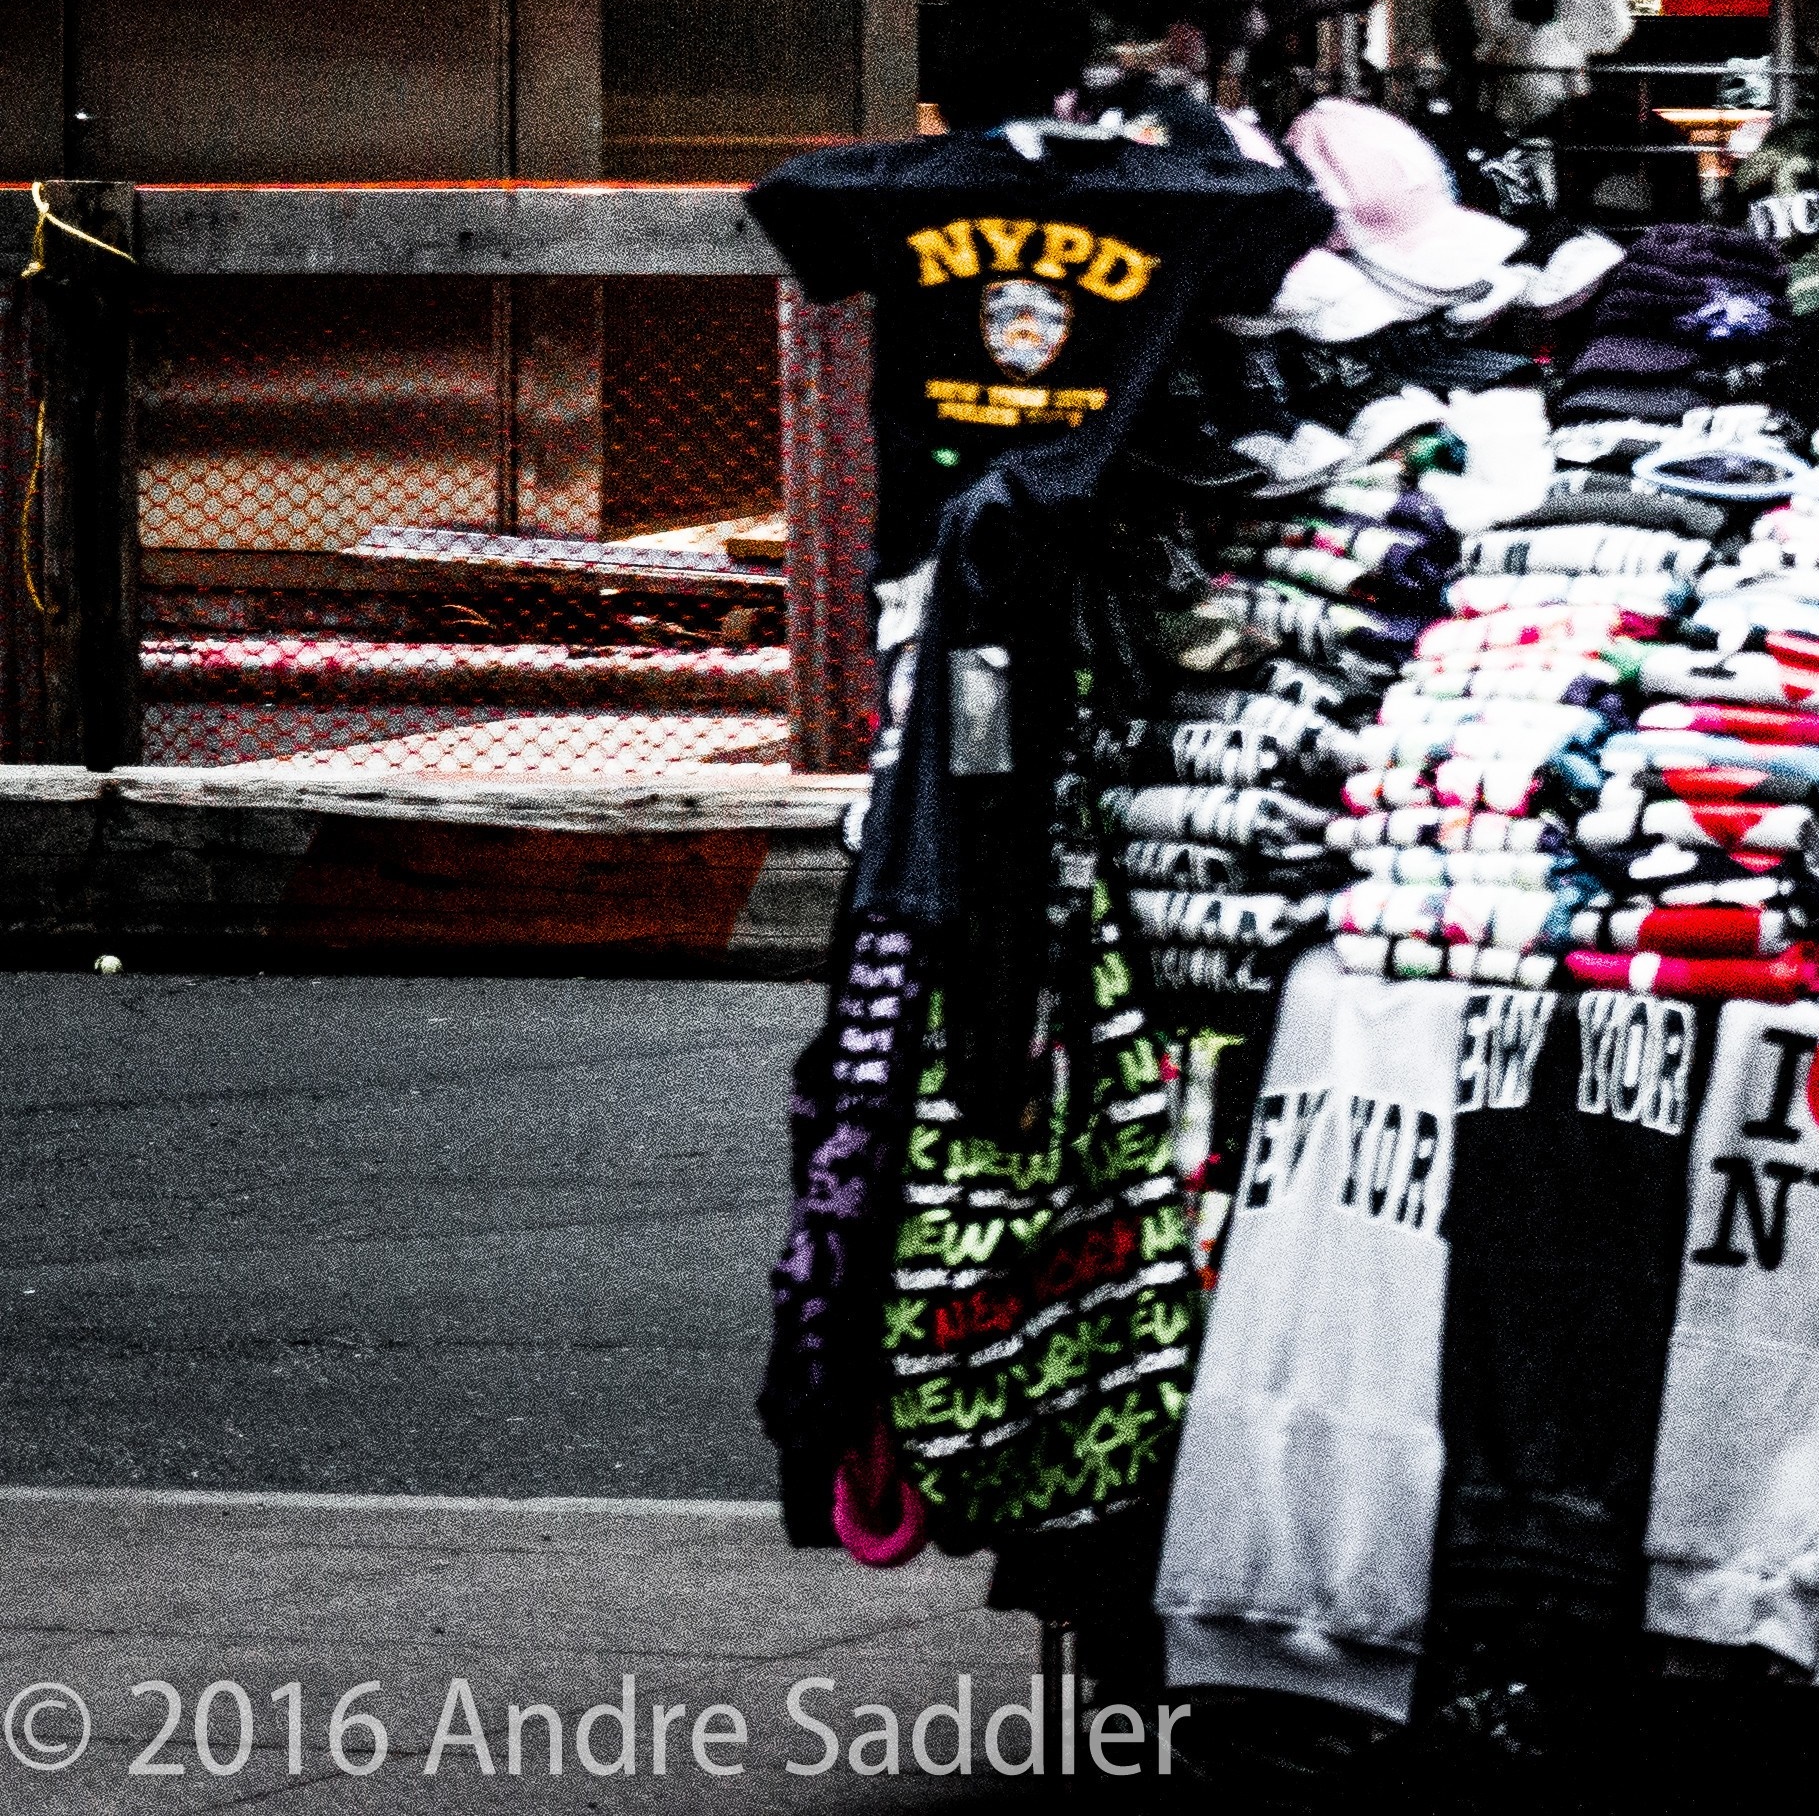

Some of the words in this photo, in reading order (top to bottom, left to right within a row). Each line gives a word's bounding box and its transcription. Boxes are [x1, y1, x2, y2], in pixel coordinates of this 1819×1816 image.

[905, 214, 1162, 304] NYPD
[1455, 993, 1556, 1112] EW
[1578, 993, 1697, 1134] YOR
[1742, 1029, 1818, 1141] I
[1245, 1092, 1332, 1212] EW
[1341, 1094, 1440, 1231] YOR
